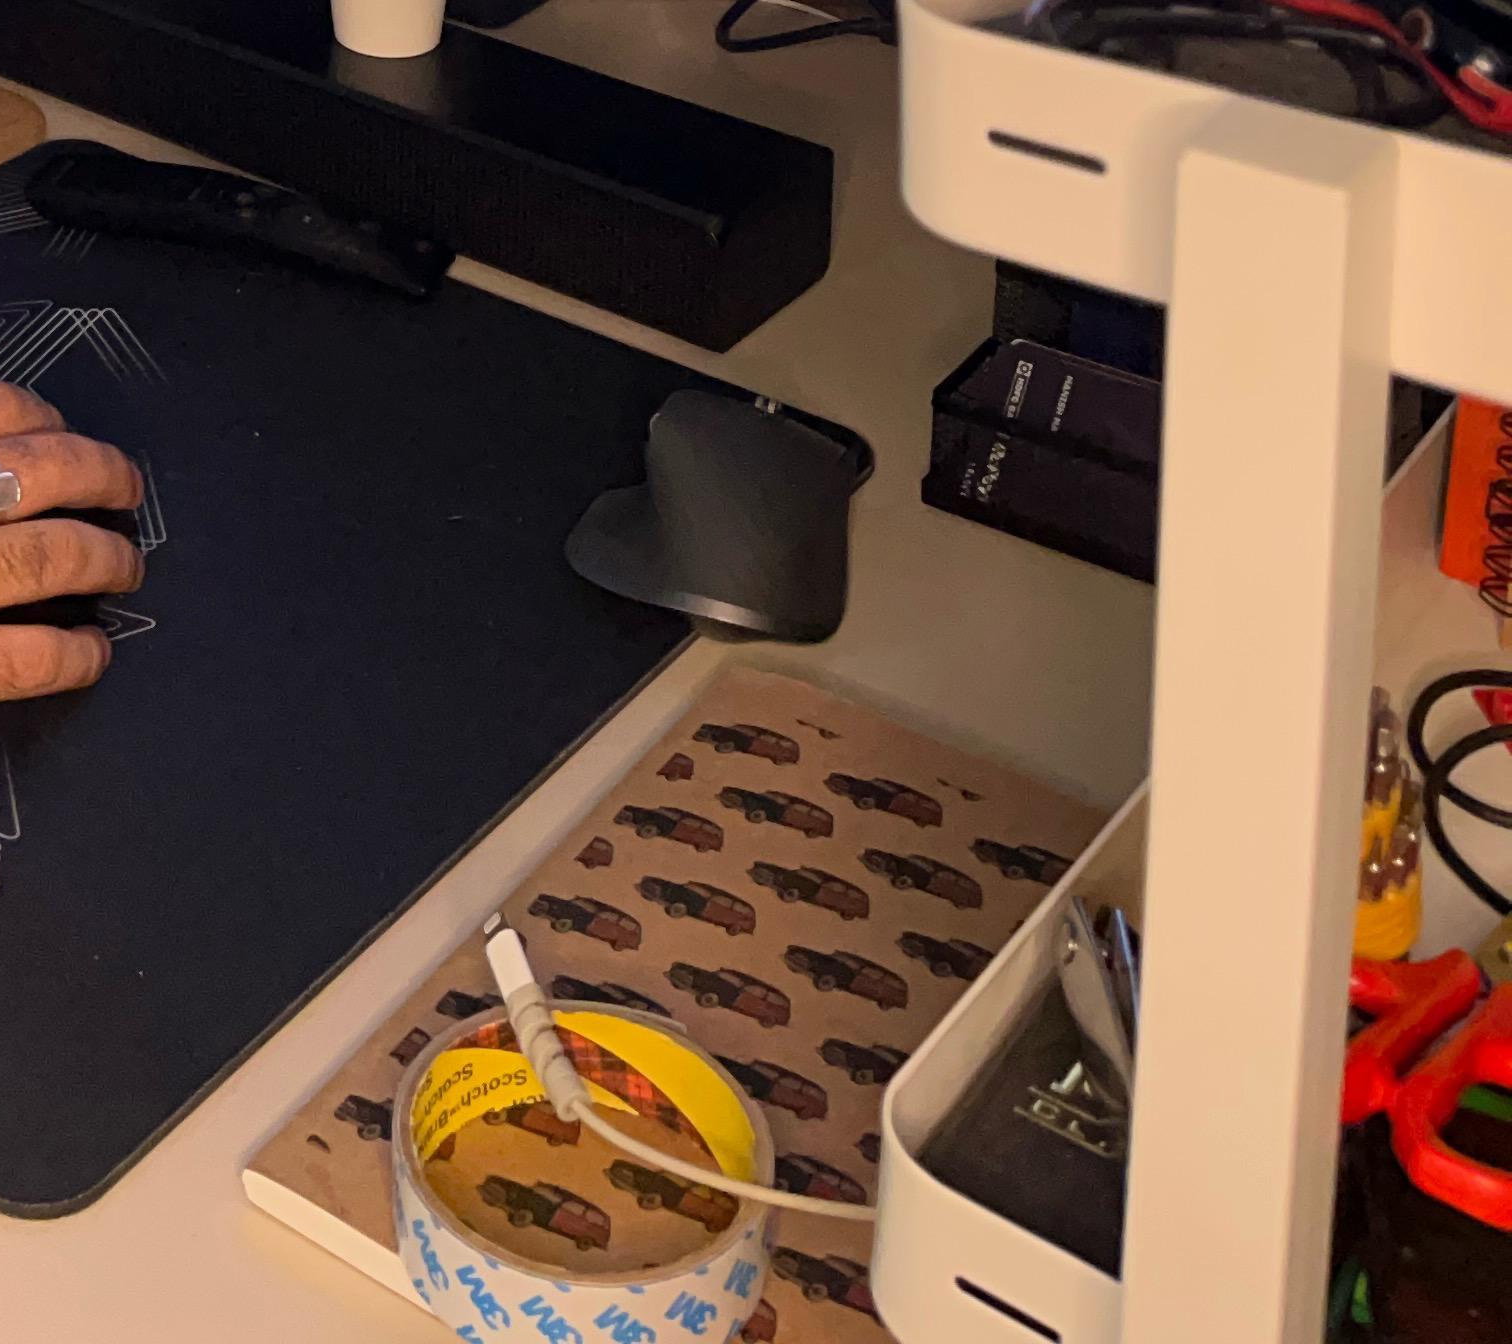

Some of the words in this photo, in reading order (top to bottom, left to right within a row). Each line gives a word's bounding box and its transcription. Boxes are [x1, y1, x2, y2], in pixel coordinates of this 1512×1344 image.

[1007, 405, 1016, 418] BA
[1011, 377, 1025, 404] HDFC
[1056, 374, 1074, 416] MANISH
[424, 1062, 474, 1116] Scotch
[412, 1218, 450, 1291] 3M
[456, 1263, 511, 1330] 3M
[723, 1257, 758, 1299] 3M
[664, 1290, 718, 1336] 3M
